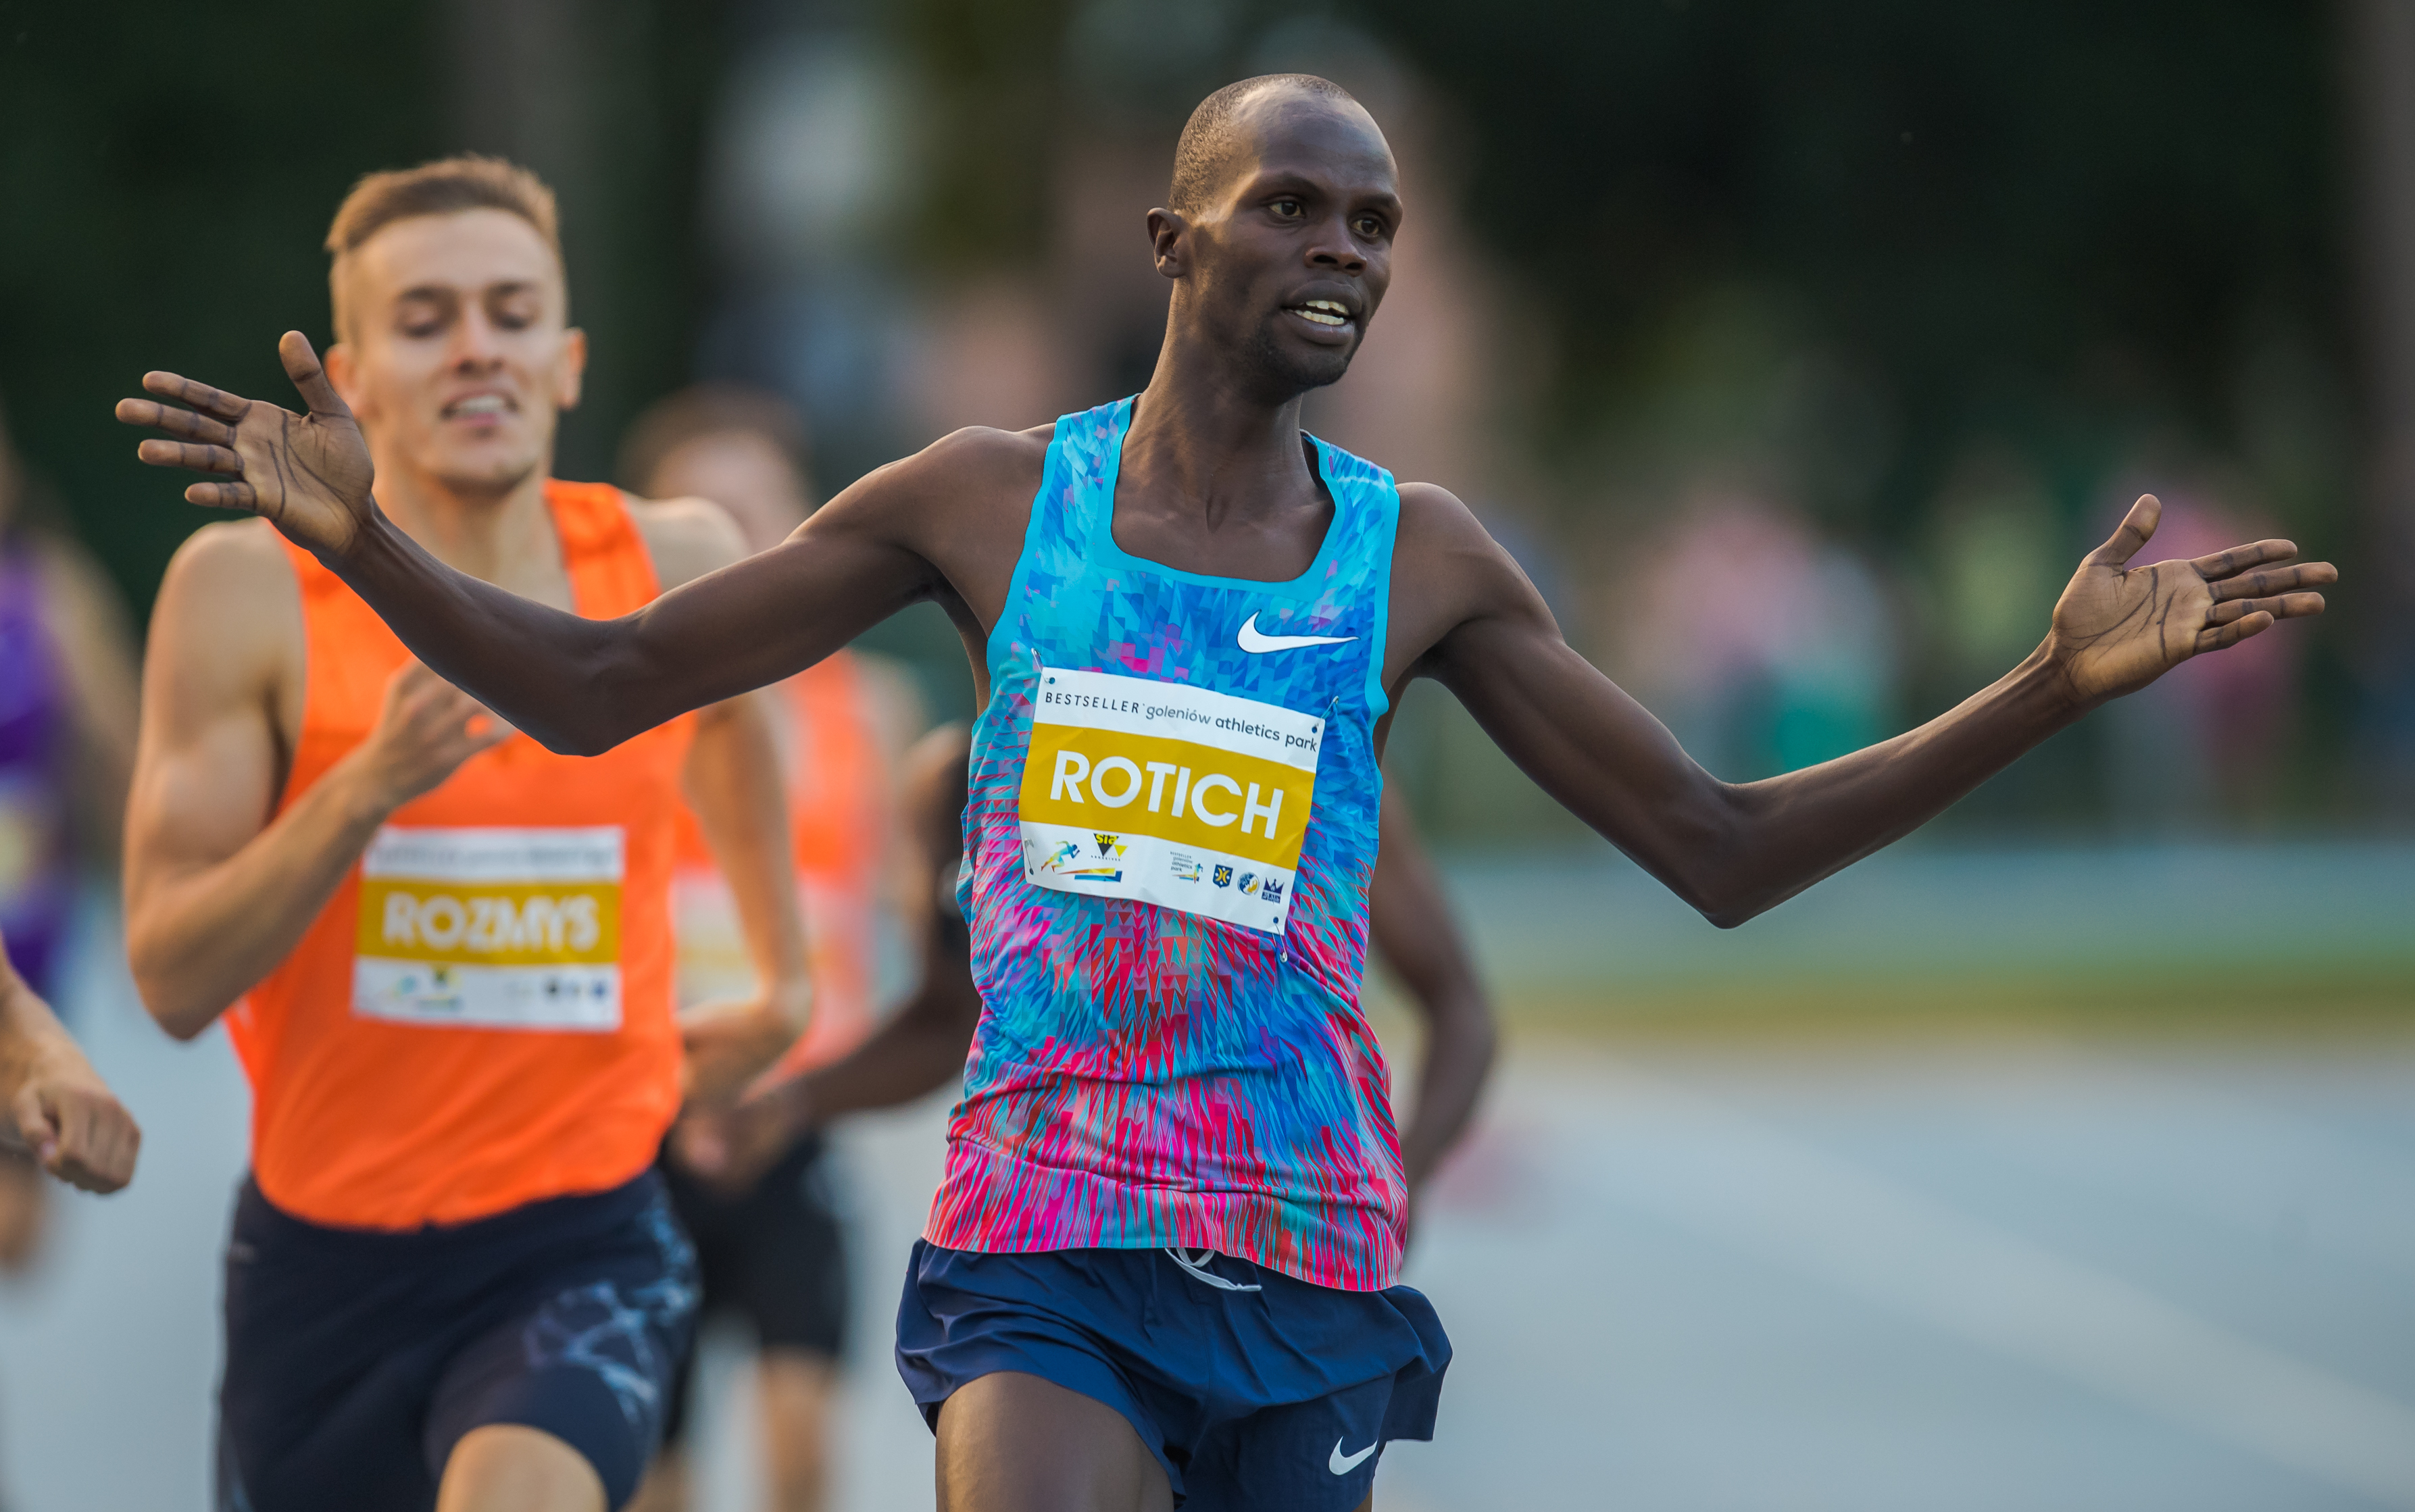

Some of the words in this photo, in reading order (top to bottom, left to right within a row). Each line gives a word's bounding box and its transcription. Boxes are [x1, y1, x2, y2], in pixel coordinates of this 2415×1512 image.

[1045, 692, 1139, 713] BESTSELLER
[1145, 705, 1212, 725] goleniów
[1216, 717, 1280, 741] athletics
[1285, 733, 1318, 753] park
[1049, 749, 1284, 840] ROTICH
